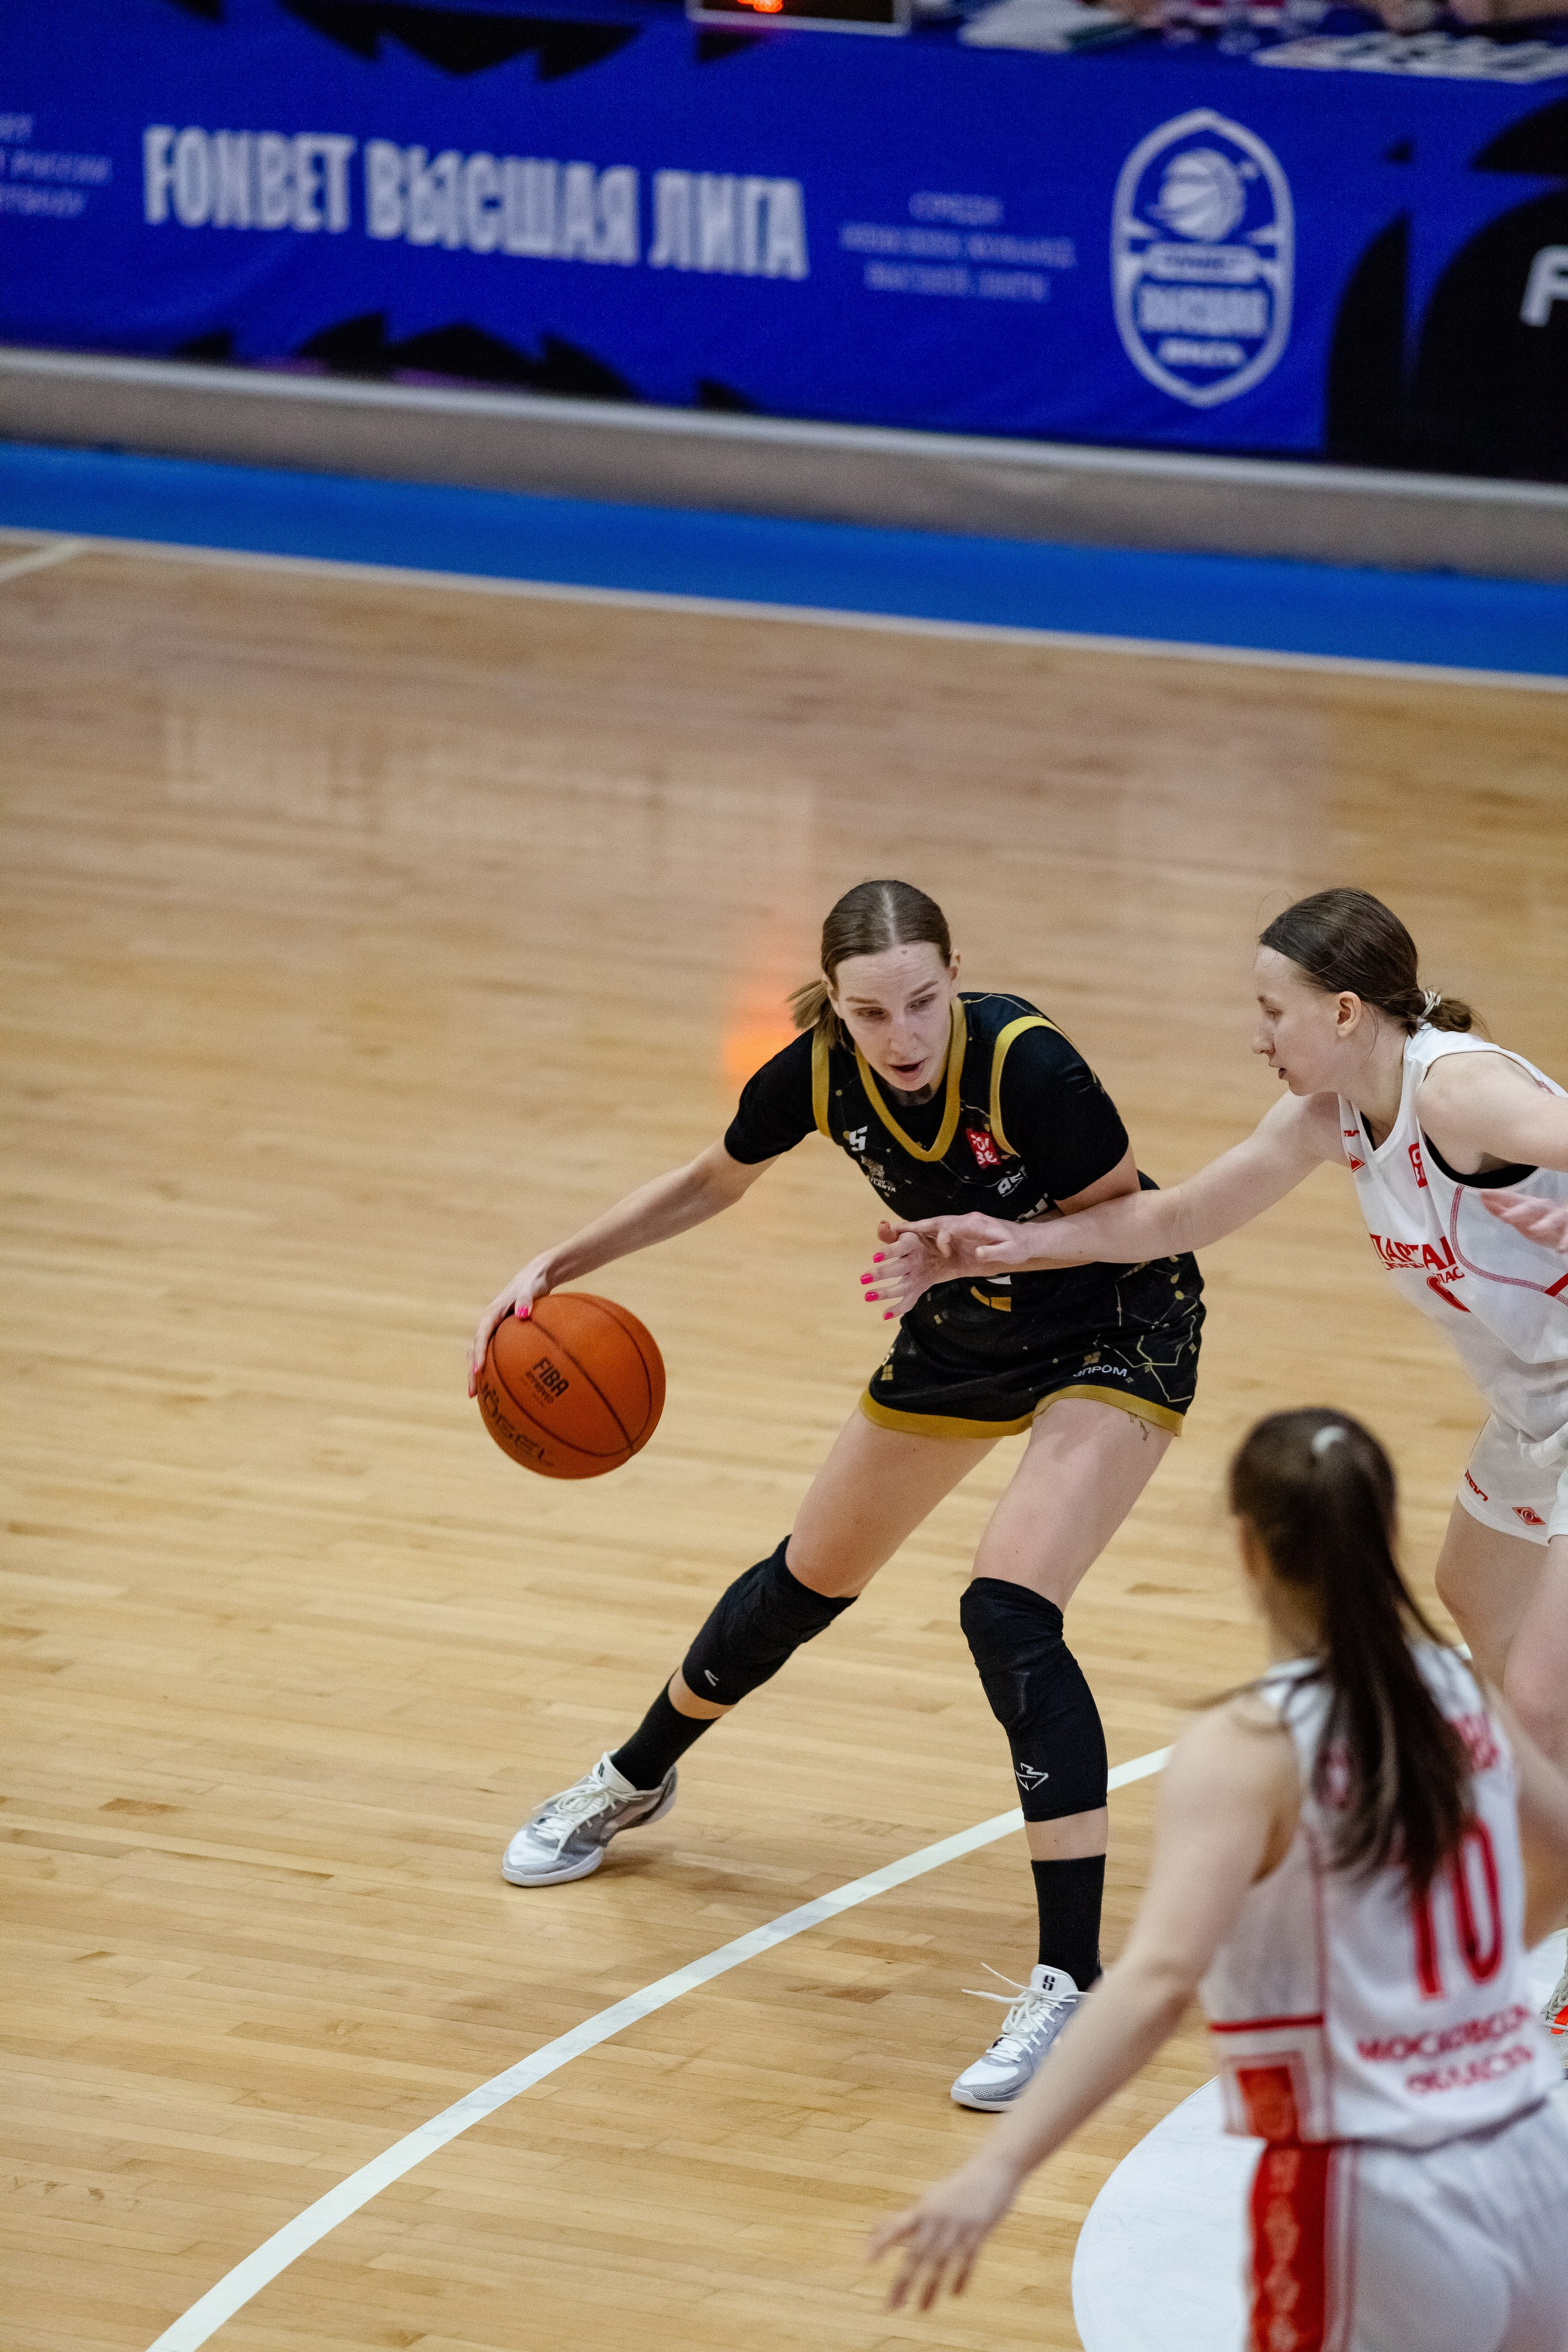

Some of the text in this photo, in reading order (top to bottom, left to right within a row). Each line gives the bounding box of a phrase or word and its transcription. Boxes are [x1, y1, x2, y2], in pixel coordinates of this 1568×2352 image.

[143, 124, 810, 281] FONBET ВЫСШАЯ ЛИГА
[870, 1177, 896, 1192] TLANTA
[1370, 1234, 1456, 1271] ПАРТА
[532, 1357, 569, 1397] FIBA
[1073, 1365, 1127, 1377] ПРОМ
